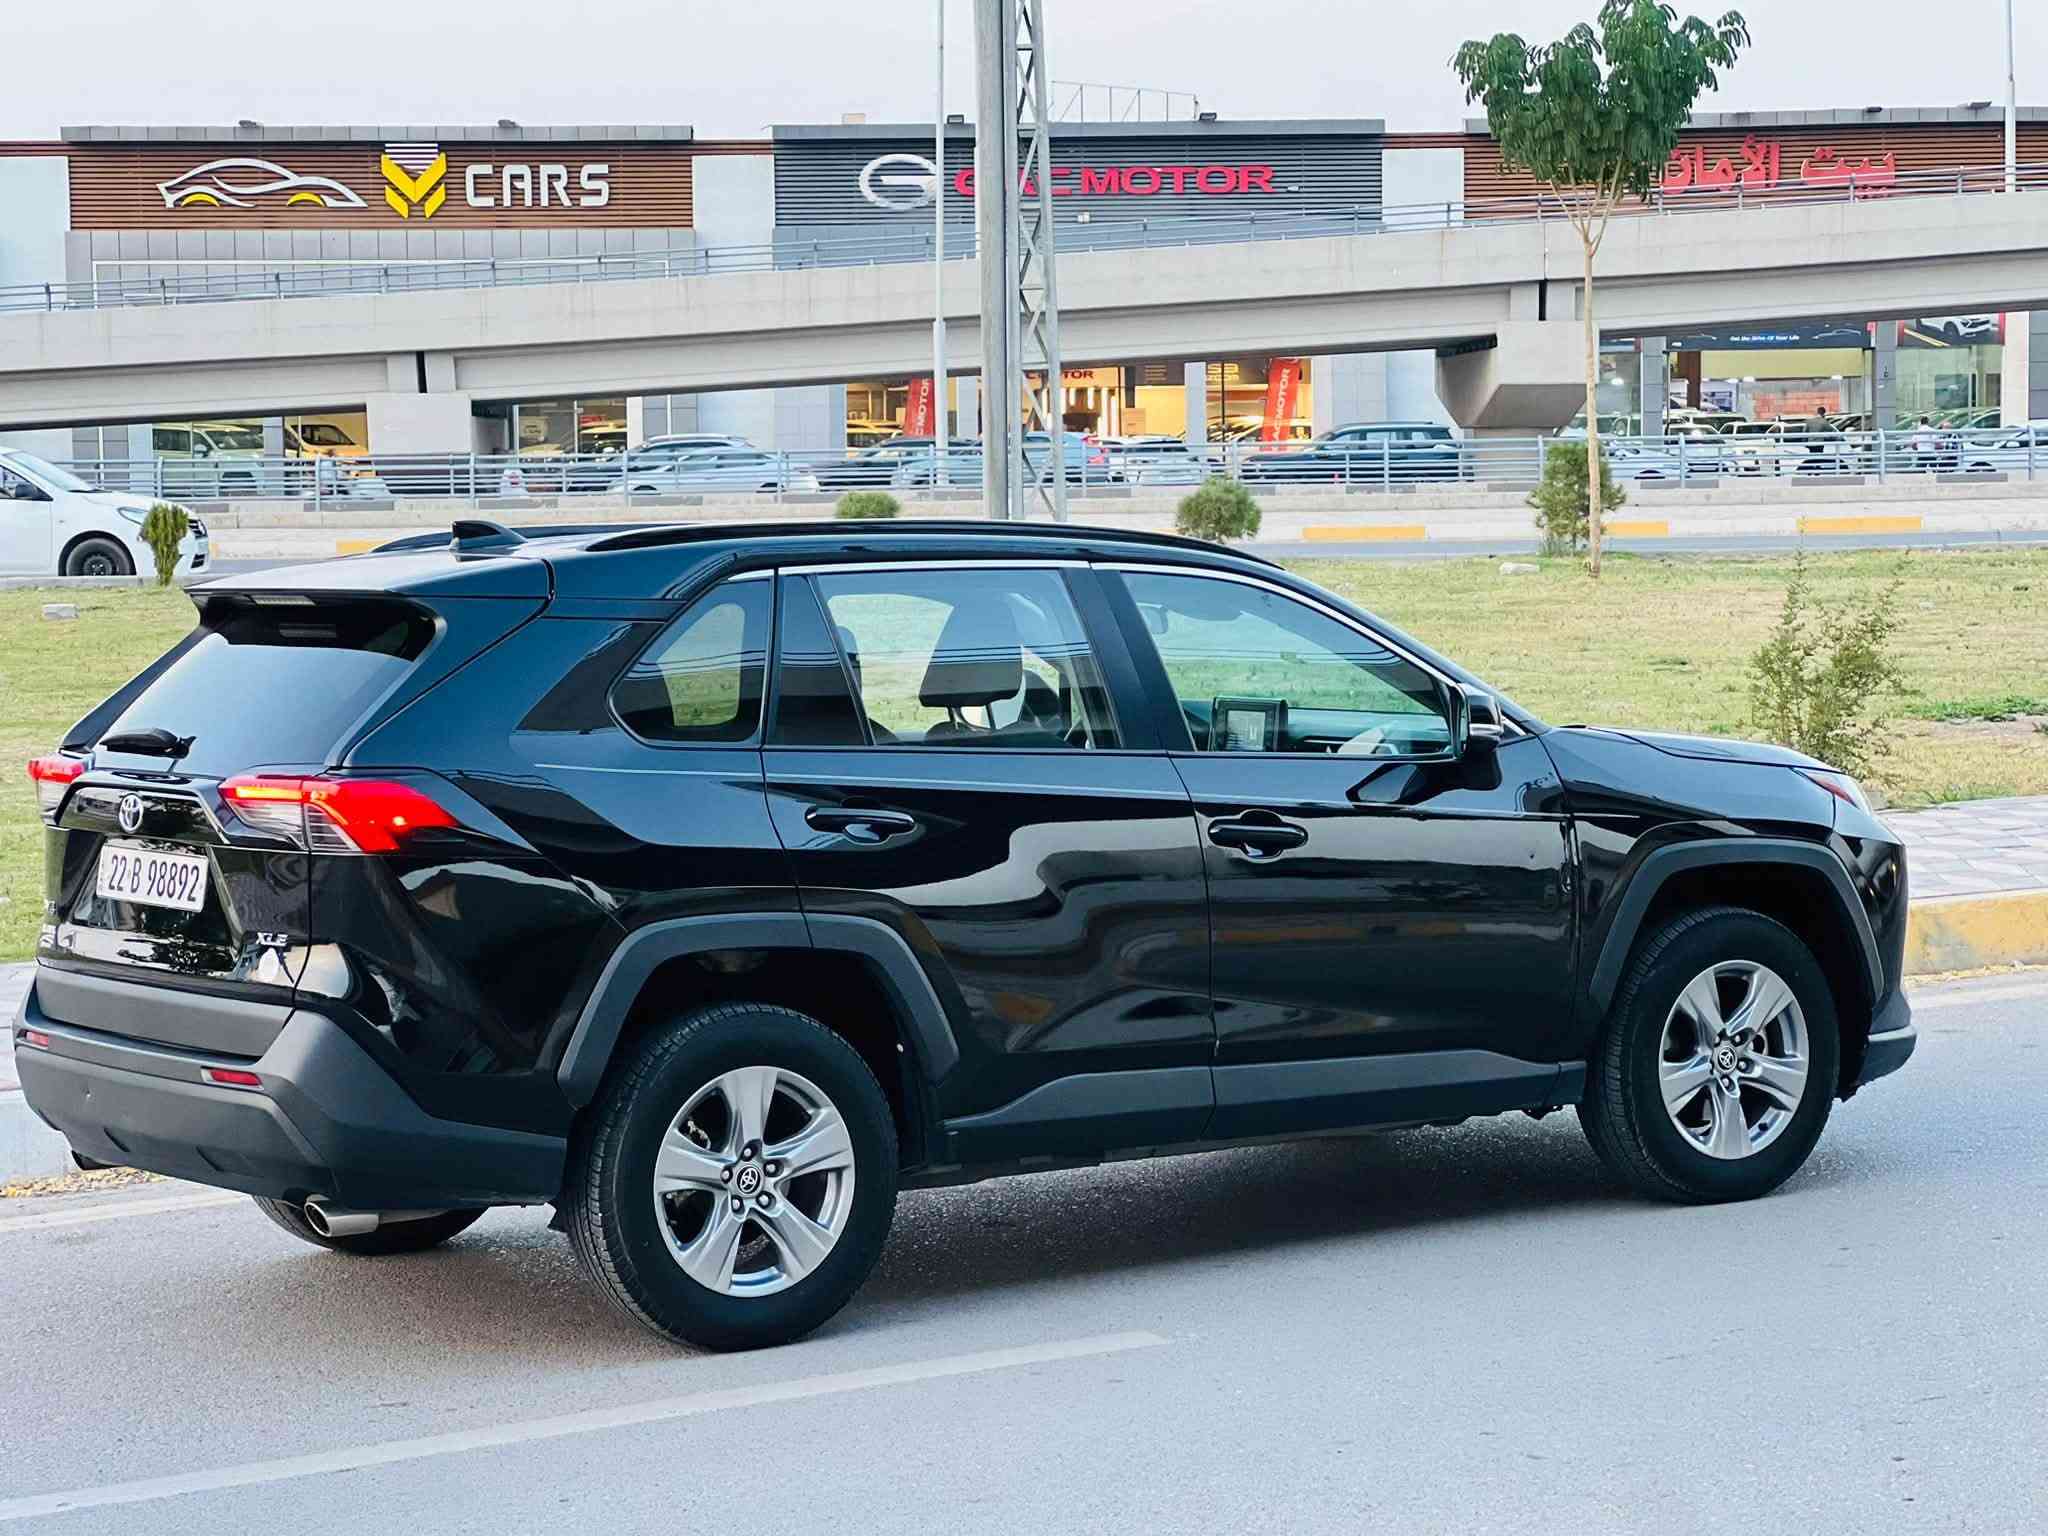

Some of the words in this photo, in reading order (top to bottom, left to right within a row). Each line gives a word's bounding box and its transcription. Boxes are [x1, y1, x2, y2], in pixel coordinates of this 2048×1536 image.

[465, 164, 609, 207] CARS
[1081, 165, 1276, 195] MOTOR
[1801, 146, 1896, 199] بيت
[109, 854, 128, 892] 22
[130, 857, 143, 894] B
[147, 859, 200, 902] 98892
[256, 932, 288, 946] XLE
